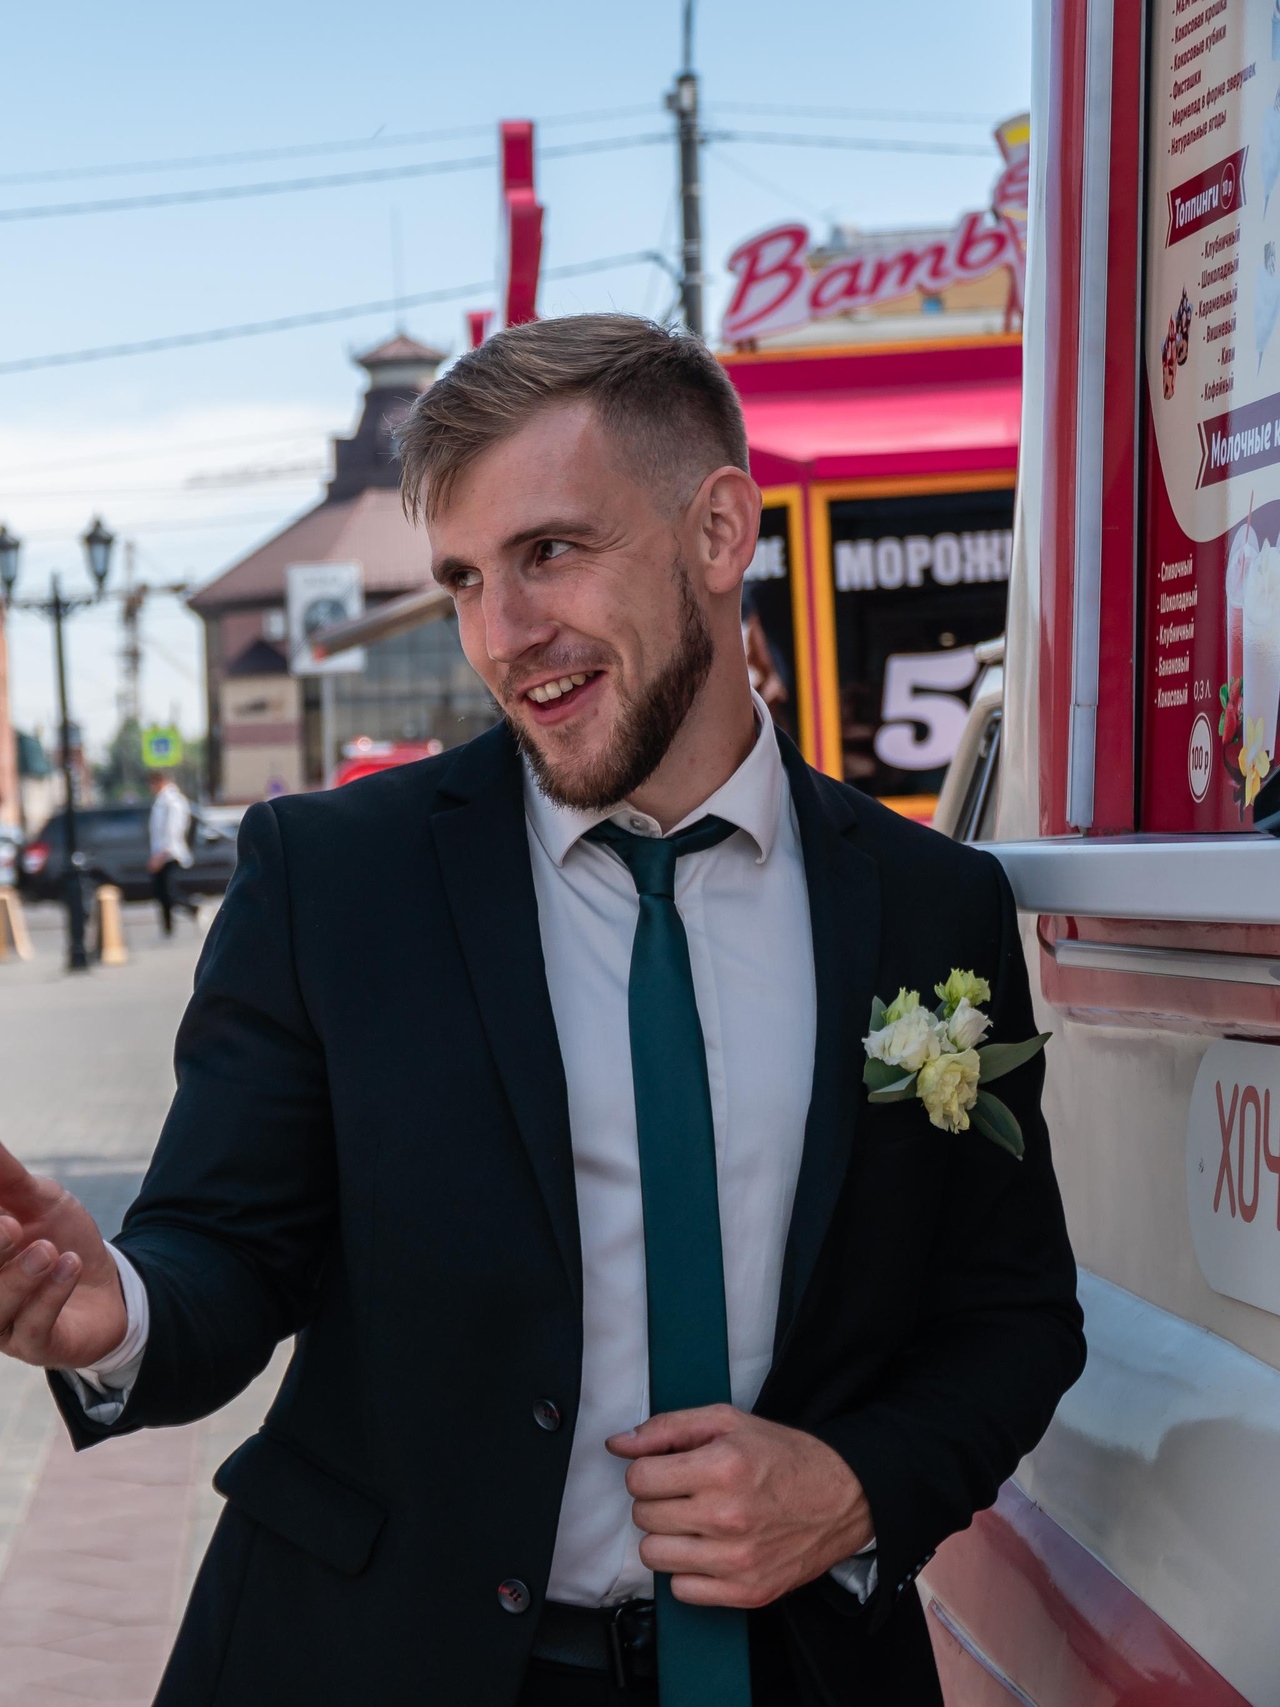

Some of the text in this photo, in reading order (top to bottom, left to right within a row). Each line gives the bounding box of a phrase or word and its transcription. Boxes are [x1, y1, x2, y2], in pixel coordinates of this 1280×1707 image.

[1175, 12, 1204, 44] Кокосовая
[1174, 24, 1227, 72] Кокосовые кубики
[1172, 62, 1256, 128] Мармелад в форме зверушек
[1173, 69, 1201, 100] Фисташки
[1170, 109, 1227, 156] Натуральные ягоды
[1175, 183, 1219, 229] Топпинги
[1204, 223, 1241, 259] Клубничный
[1201, 253, 1239, 289] Шоколадный
[1198, 282, 1238, 320] Карамельный
[1221, 347, 1235, 366] Киви
[1204, 371, 1234, 402] Кофейный
[1211, 422, 1272, 469] Молочные
[834, 529, 1012, 592] МОРОЖ
[1161, 553, 1193, 582] Сливочный
[1160, 583, 1198, 614] Шоколадный
[1159, 617, 1195, 649] Клубничный
[1158, 650, 1190, 677] Банановый
[1158, 682, 1189, 709] Кокосовый
[1192, 745, 1203, 771] 100
